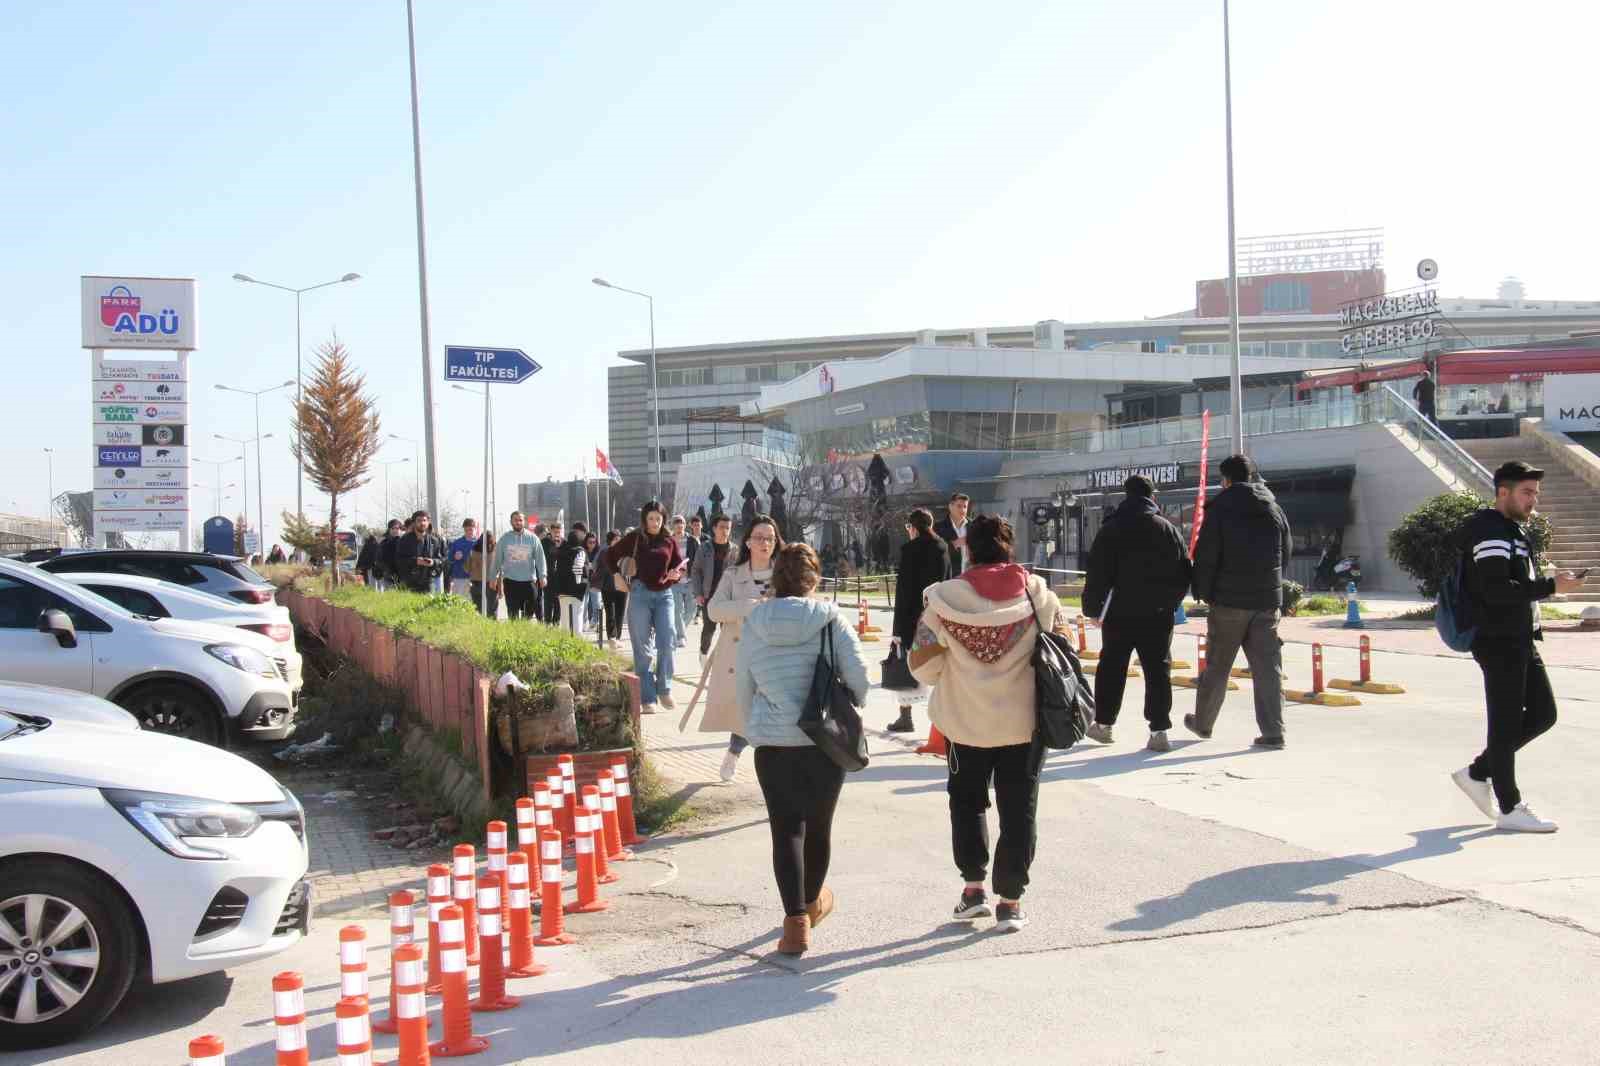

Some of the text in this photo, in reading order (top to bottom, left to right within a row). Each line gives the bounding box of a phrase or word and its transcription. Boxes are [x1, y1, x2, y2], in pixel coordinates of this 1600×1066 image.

[103, 298, 140, 306] PARK
[114, 308, 179, 334] ADÜ
[474, 351, 496, 362] TIP
[450, 365, 518, 378] FAKÜLTESİ
[105, 413, 134, 421] BABA
[1094, 468, 1128, 488] YEMEN
